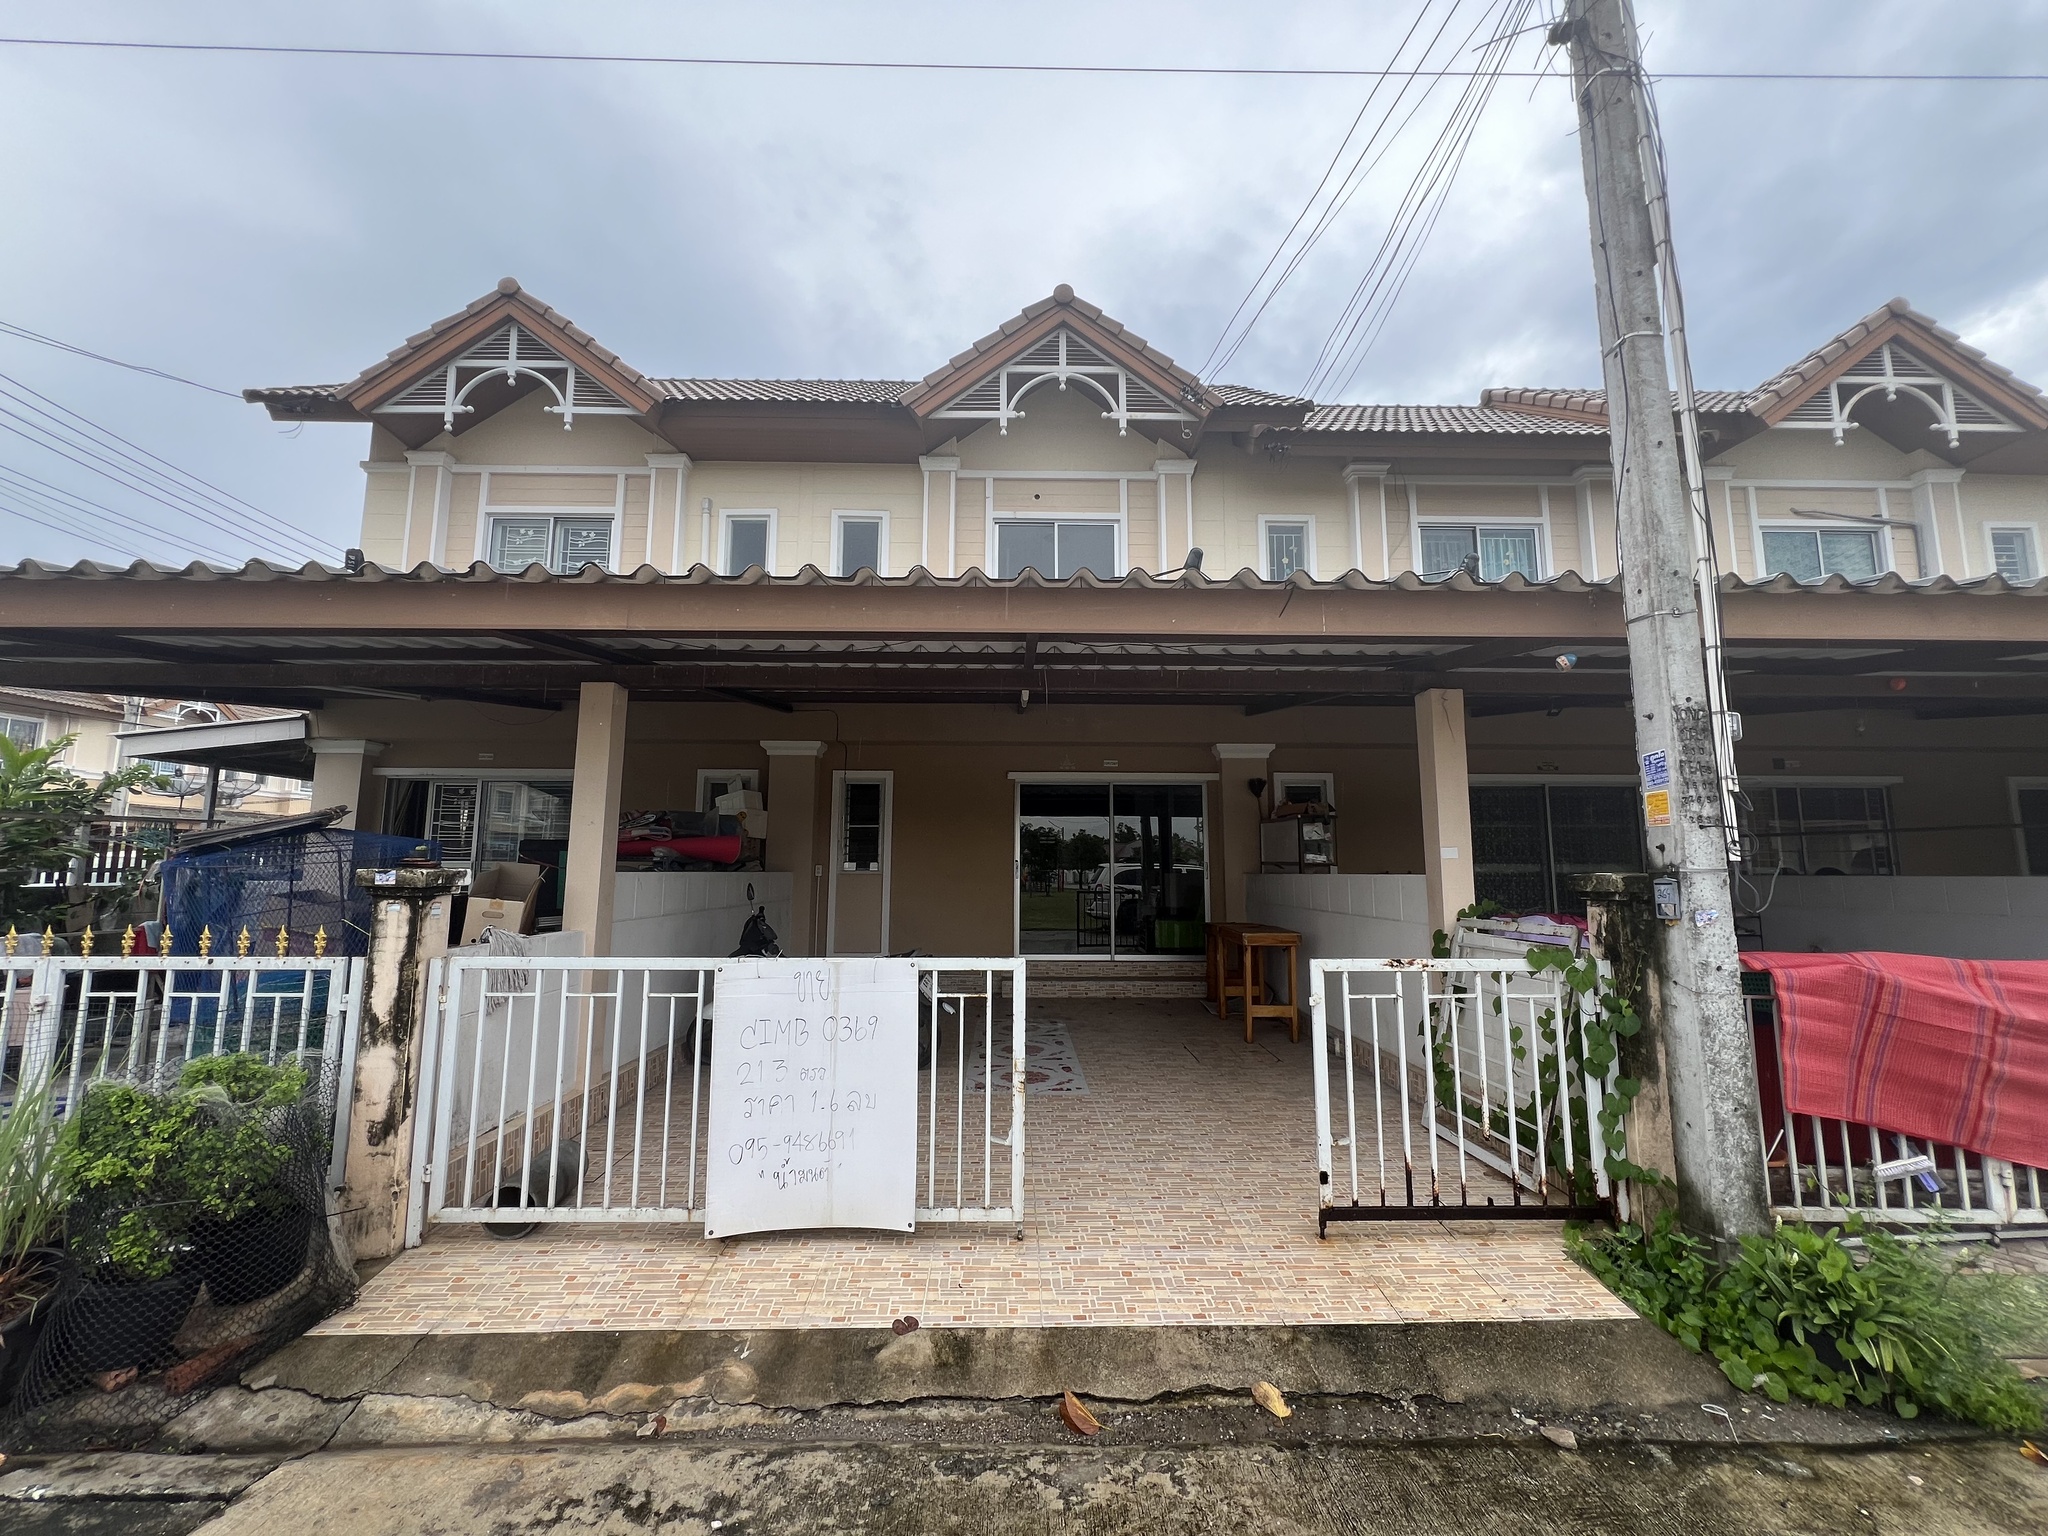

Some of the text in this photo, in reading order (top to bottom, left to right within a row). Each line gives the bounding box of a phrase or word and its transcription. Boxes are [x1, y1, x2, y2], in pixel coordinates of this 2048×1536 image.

[793, 967, 831, 1003] ขาย
[739, 1015, 879, 1050] CIMB 0369
[743, 1094, 795, 1119] ราคา
[811, 1088, 839, 1113] 1.6
[728, 1127, 856, 1166] 095-9486691
